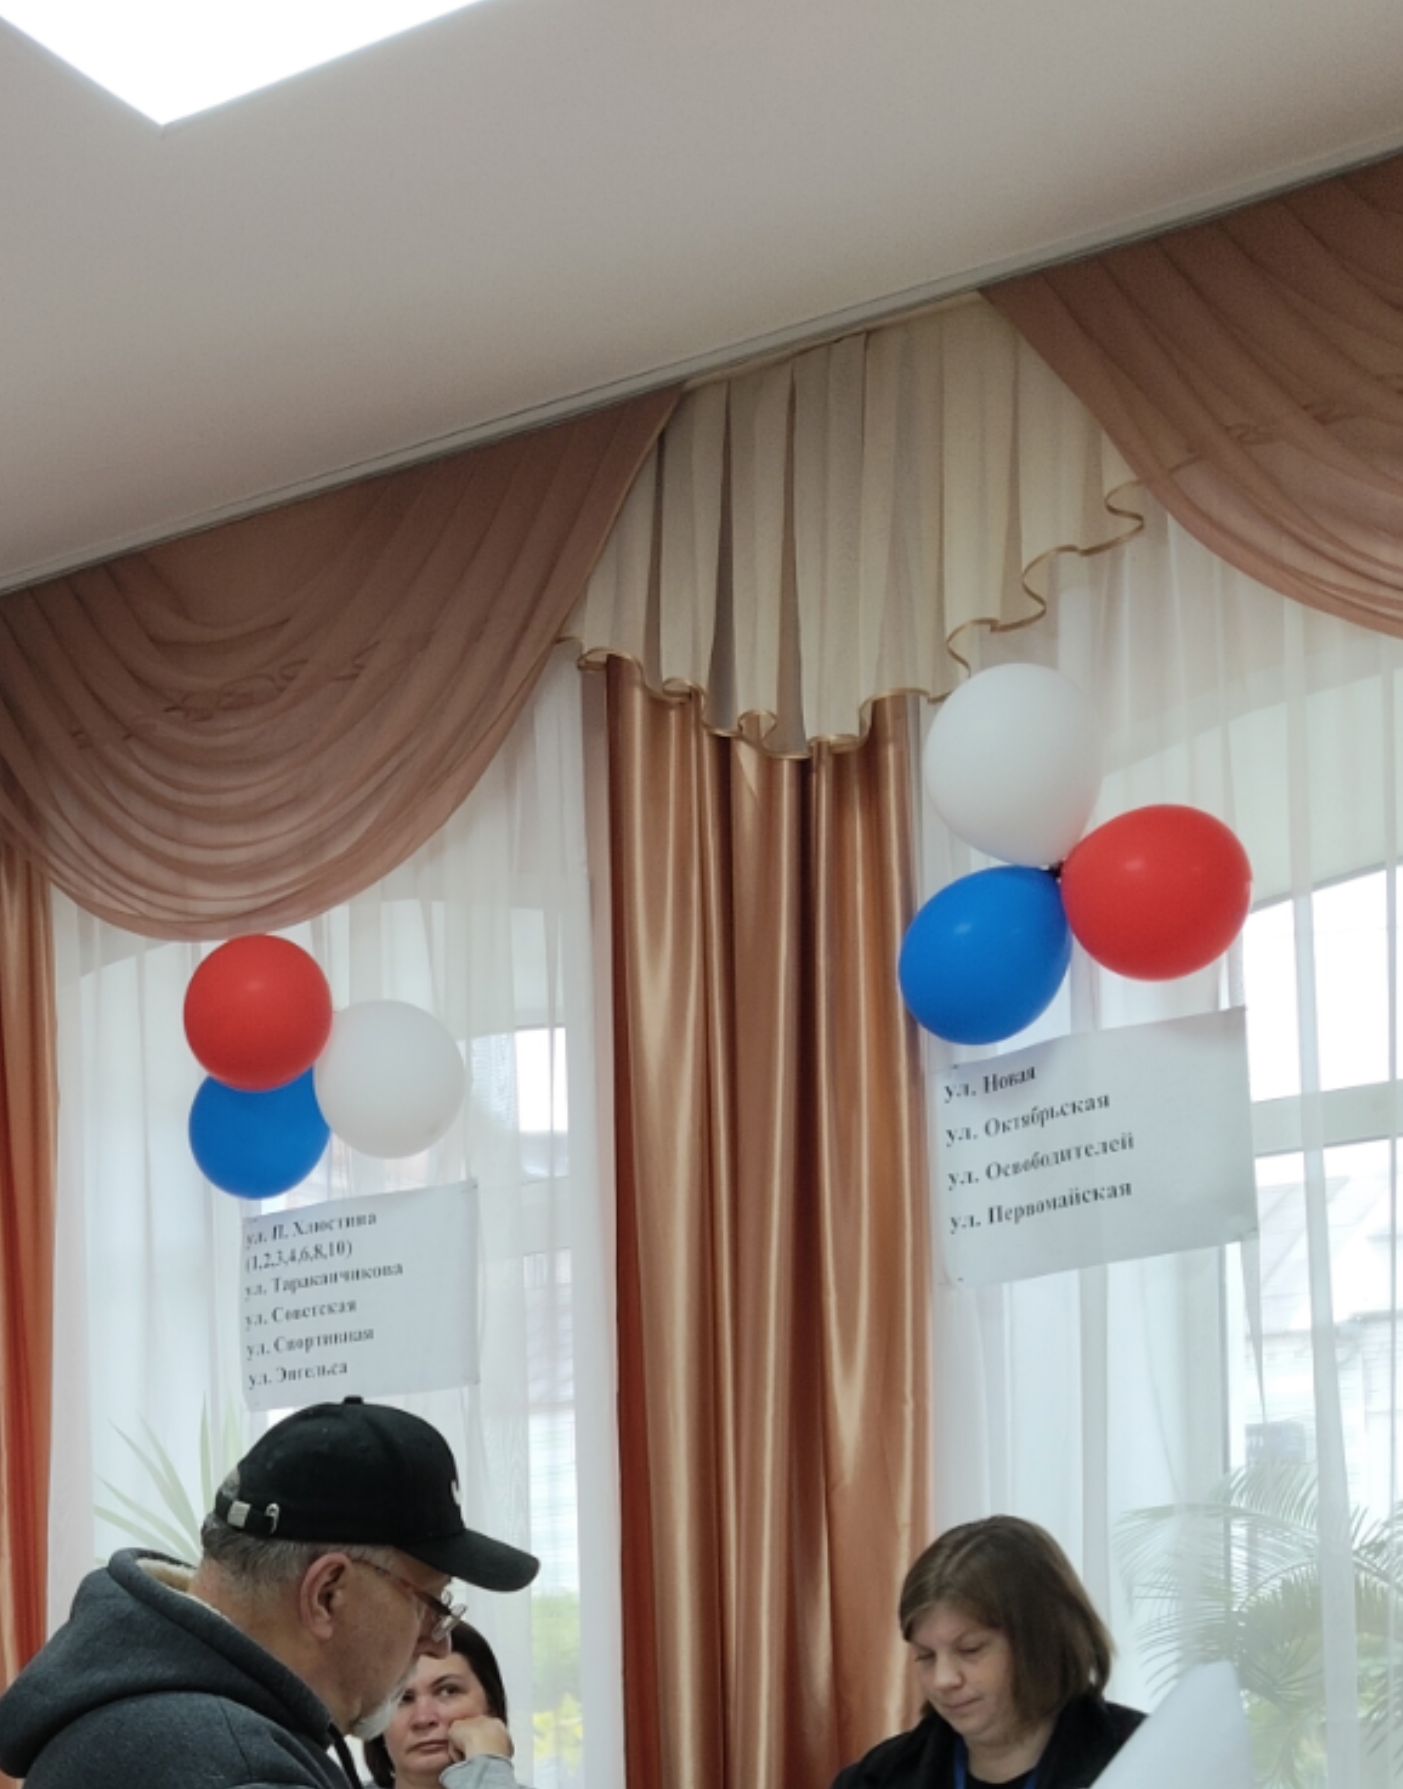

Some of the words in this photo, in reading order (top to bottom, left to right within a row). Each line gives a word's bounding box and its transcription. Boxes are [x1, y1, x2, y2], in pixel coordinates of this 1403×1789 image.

[944, 1081, 977, 1104] ул.
[982, 1065, 1037, 1094] Новая
[945, 1124, 978, 1147] ул.
[984, 1092, 1111, 1138] Октябрьская
[948, 1169, 980, 1191] ул.
[985, 1131, 1135, 1181] Освободителей
[949, 1212, 982, 1234] ул.
[987, 1180, 1133, 1225] Первомайская
[246, 1231, 268, 1250] ул.
[245, 1283, 268, 1302] ул.
[245, 1312, 268, 1332] ул.
[271, 1299, 357, 1324] Советская
[246, 1342, 271, 1361] ул.
[248, 1371, 272, 1390] ул.
[276, 1361, 348, 1384] Энгельса
